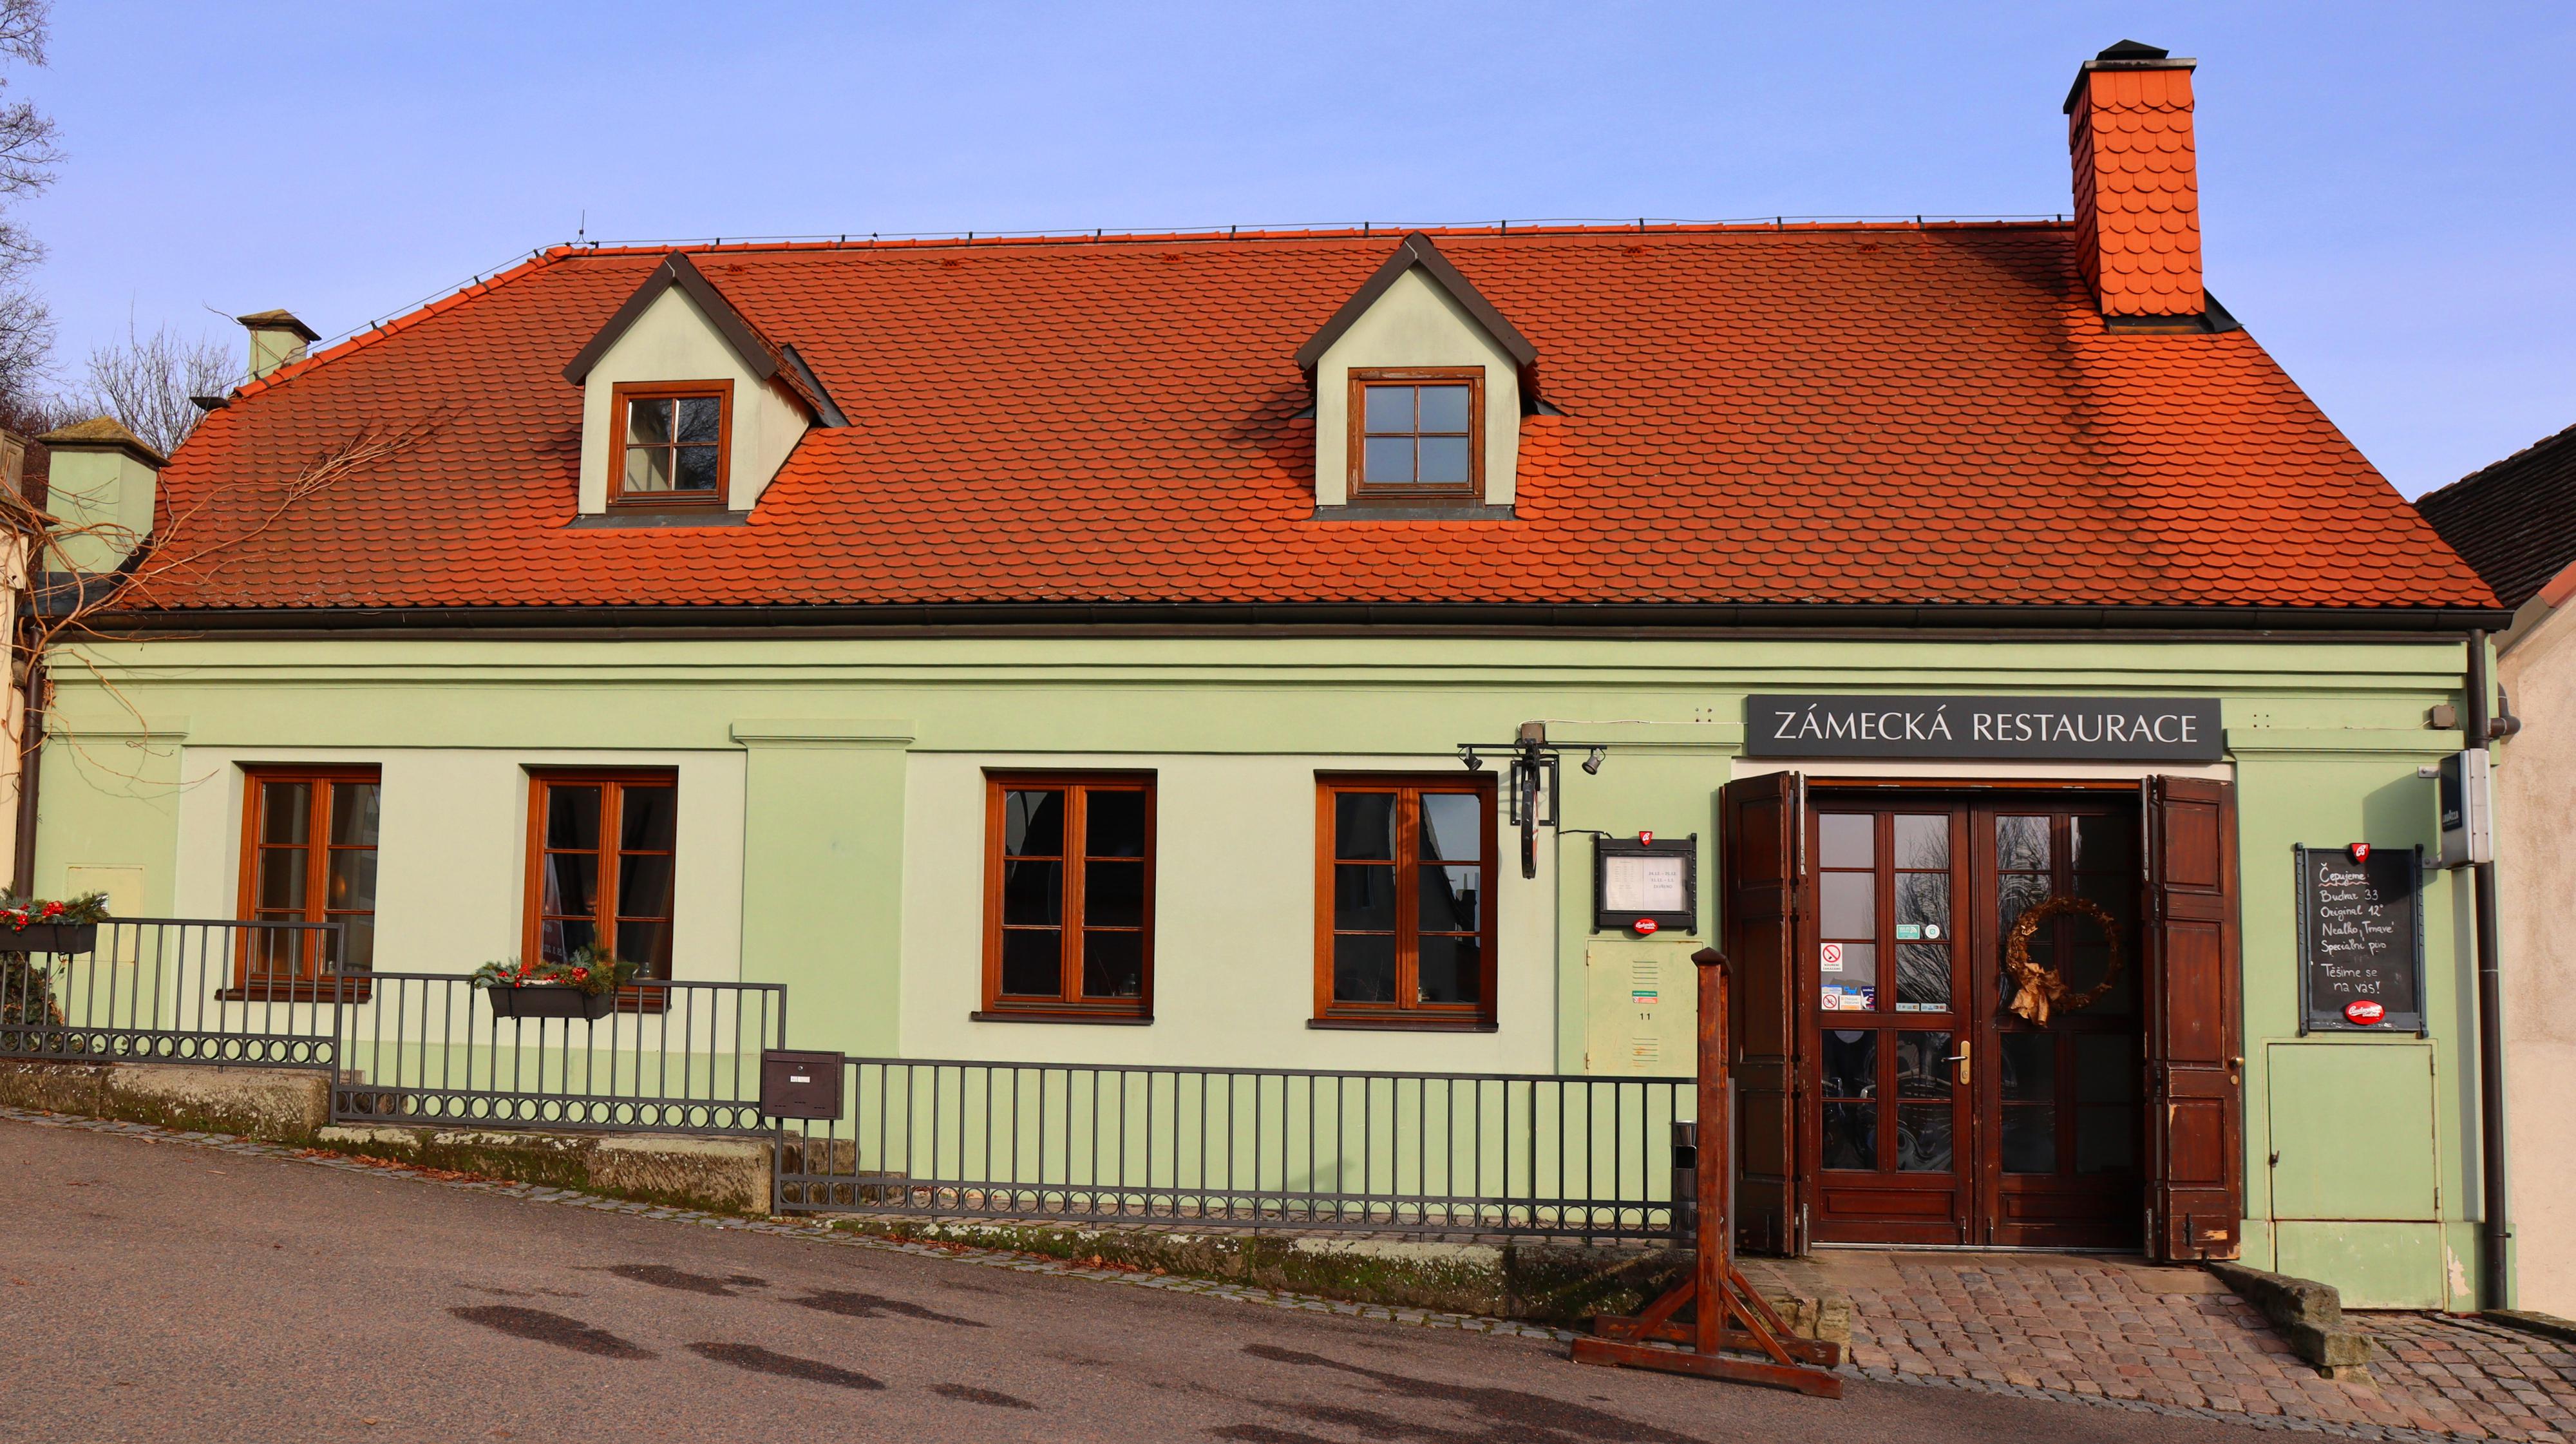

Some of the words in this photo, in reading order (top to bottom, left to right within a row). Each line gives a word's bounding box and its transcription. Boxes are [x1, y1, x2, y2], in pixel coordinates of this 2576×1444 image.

[1774, 703, 1953, 741] ZÁMECKÁ
[1973, 713, 2197, 743] RESTAURACE
[2319, 889, 2358, 902] Budvar
[2364, 889, 2378, 900] 33
[2334, 982, 2349, 992] na
